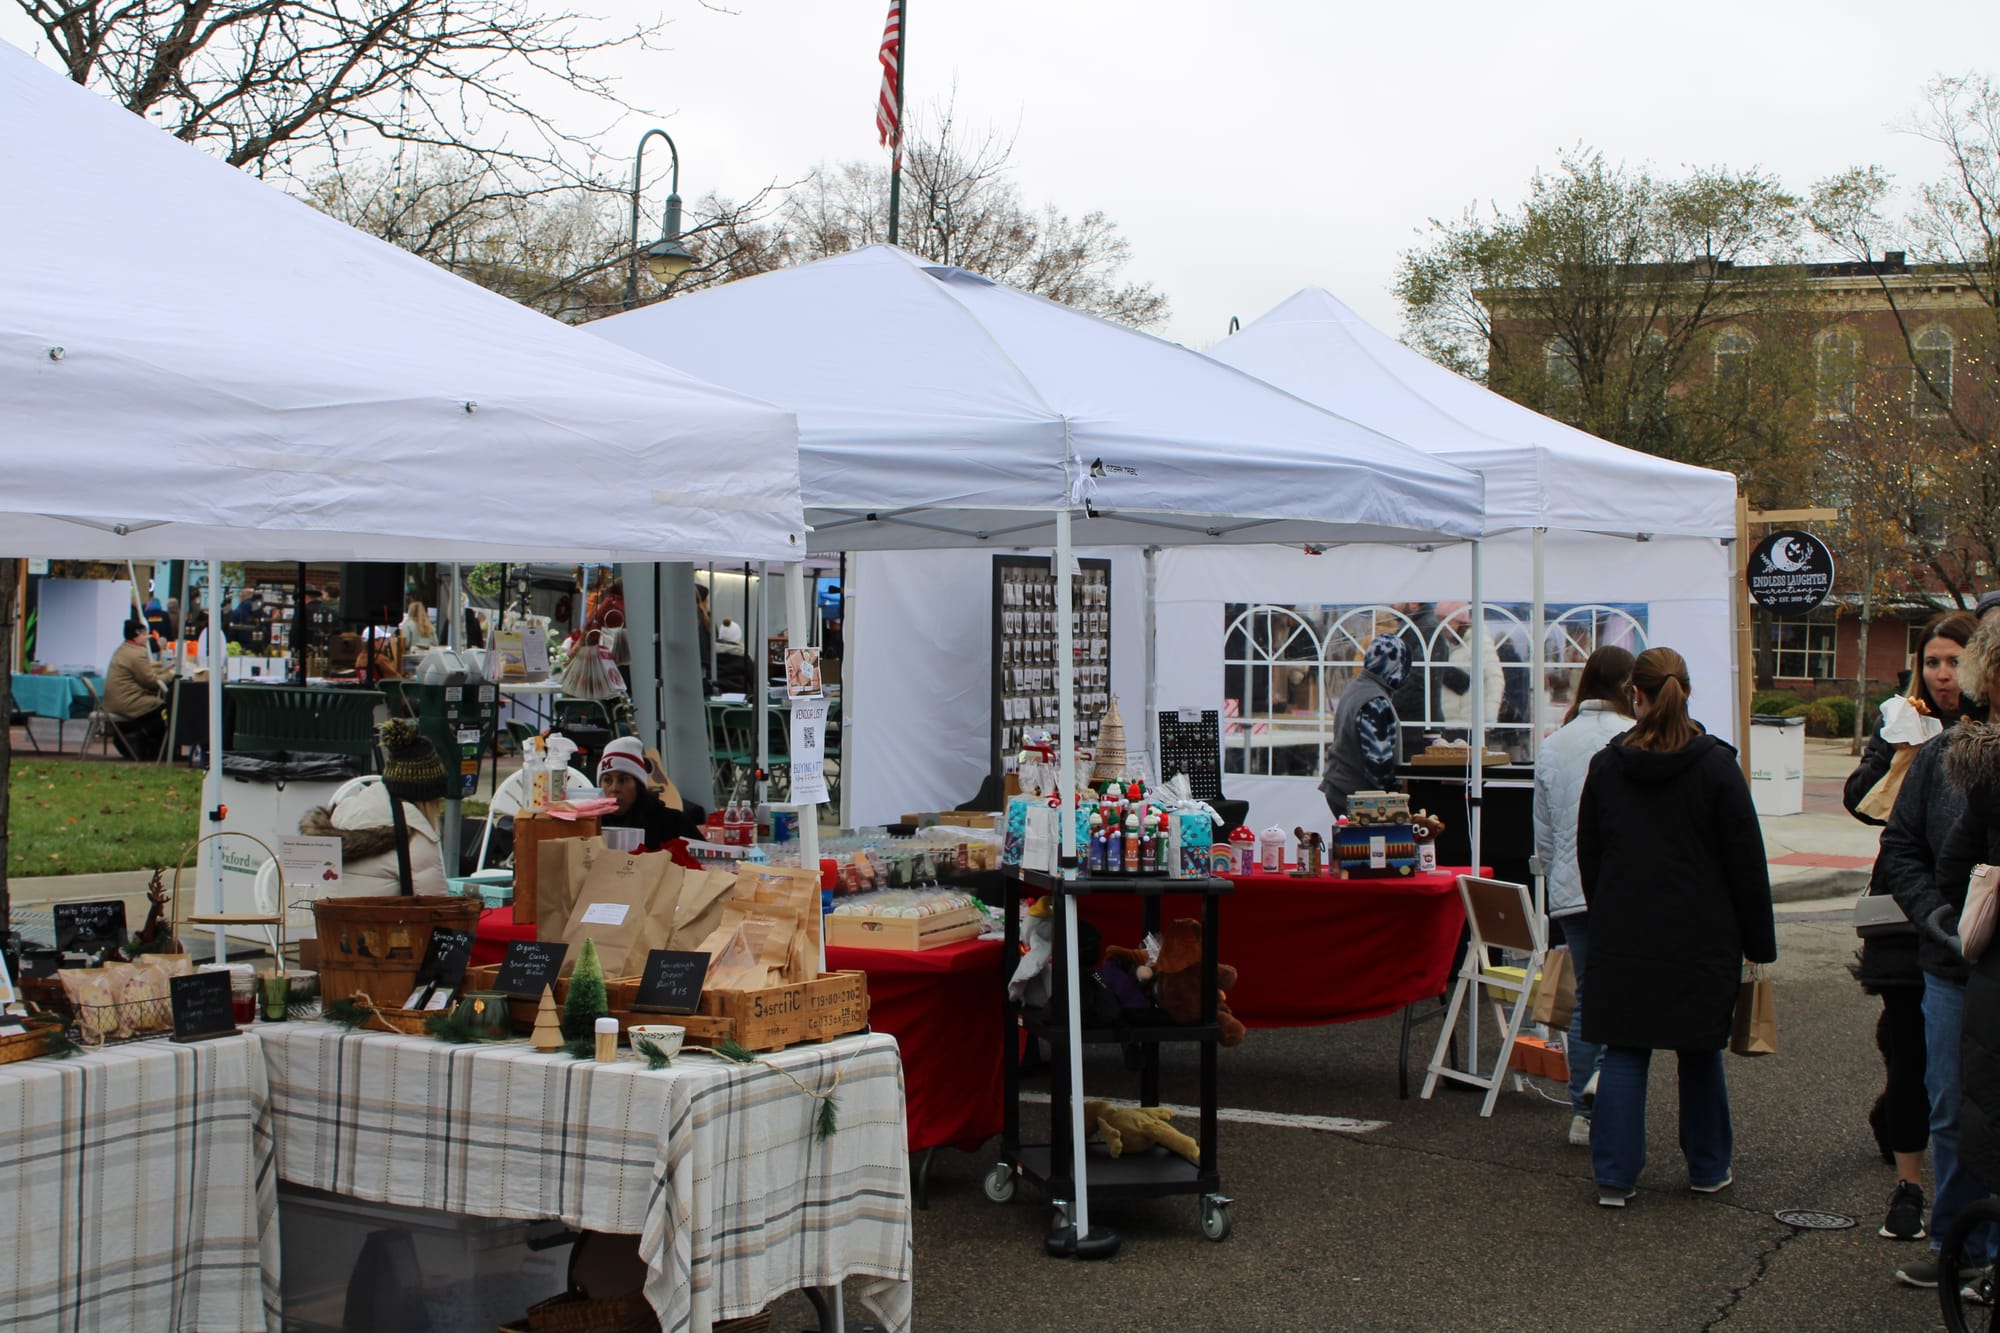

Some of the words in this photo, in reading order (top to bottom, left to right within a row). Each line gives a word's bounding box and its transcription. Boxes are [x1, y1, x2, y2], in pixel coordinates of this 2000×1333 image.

[1752, 575, 1786, 588] ENDLESS
[1787, 573, 1827, 586] LAUGHTER
[1760, 586, 1818, 595] creations
[602, 757, 614, 771] M
[465, 774, 472, 787] 2
[222, 851, 251, 867] xford
